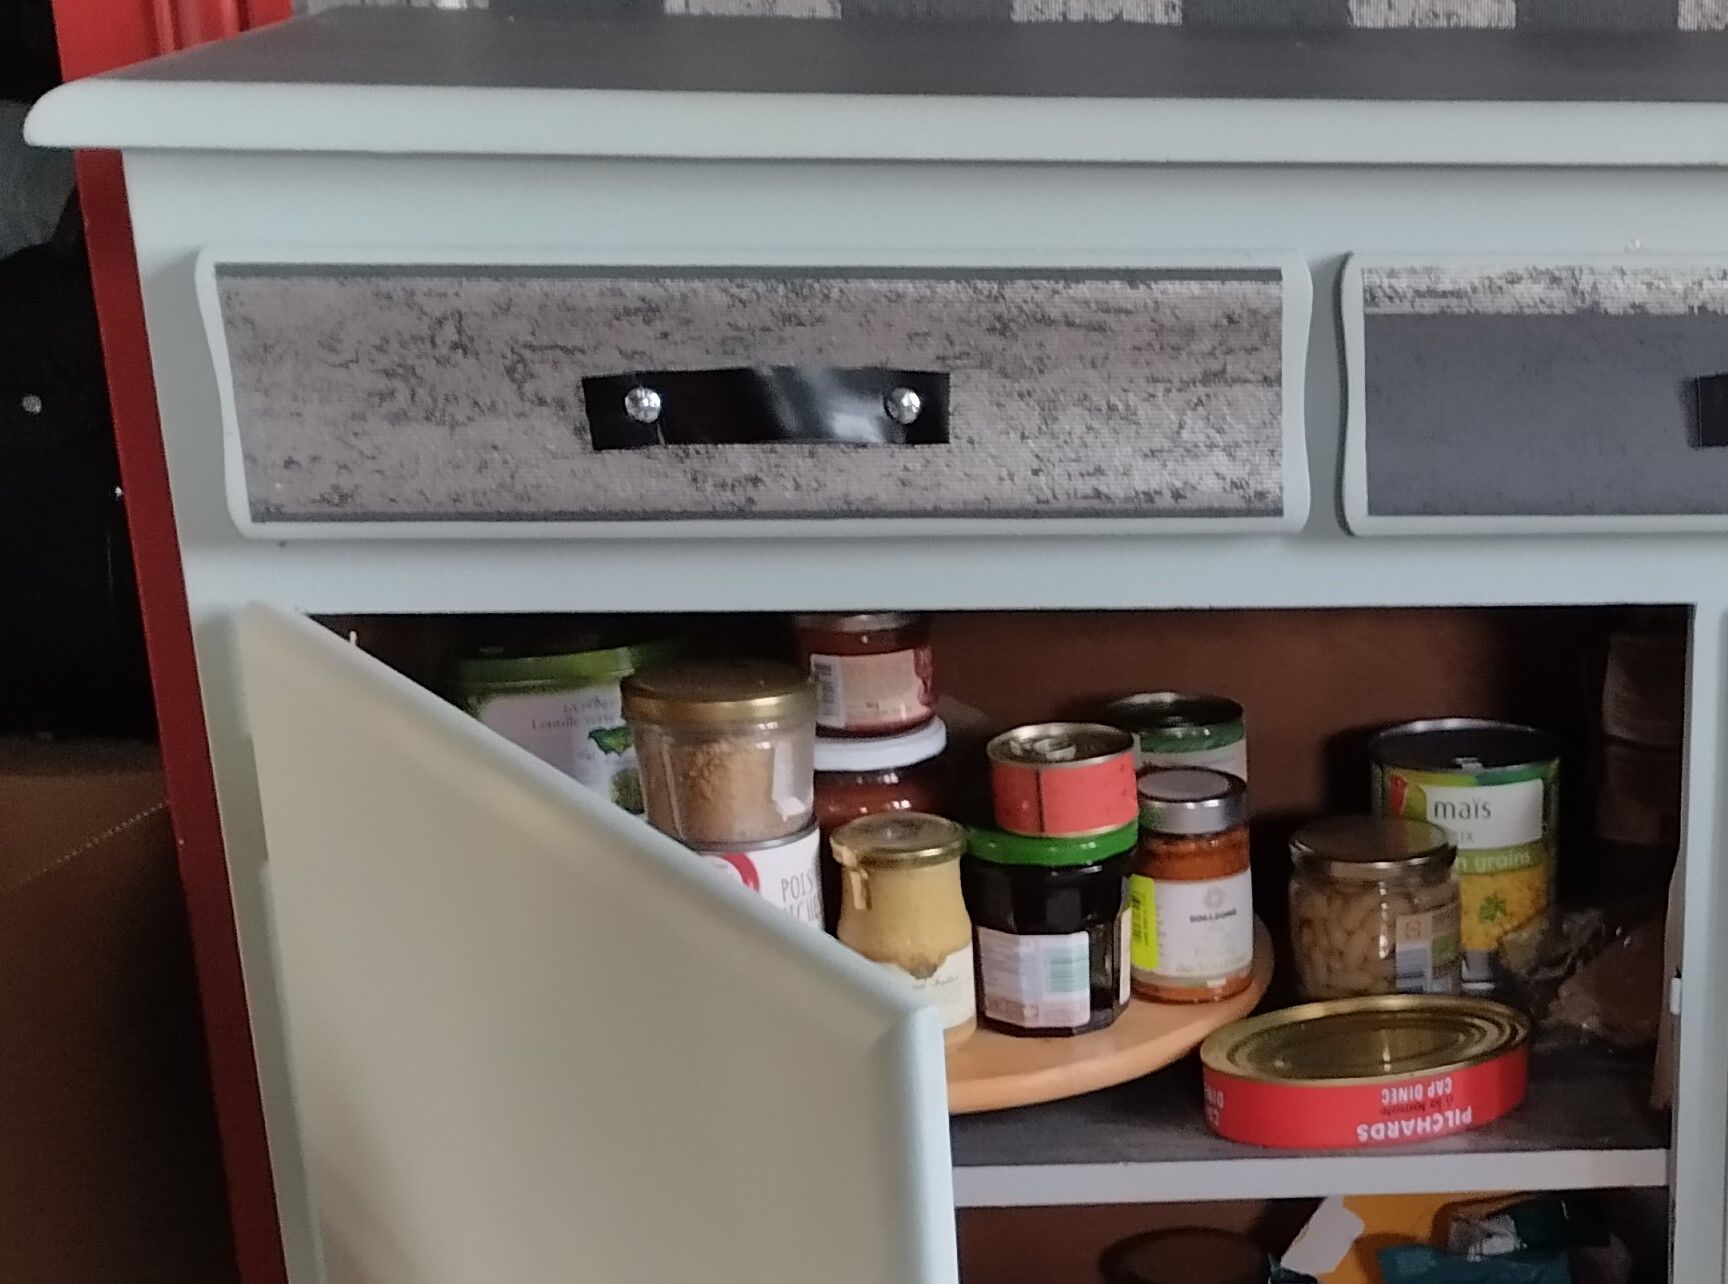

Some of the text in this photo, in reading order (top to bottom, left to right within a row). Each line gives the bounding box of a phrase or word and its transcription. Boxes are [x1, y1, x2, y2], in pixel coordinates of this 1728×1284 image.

[1434, 797, 1492, 820] maïs
[1426, 1075, 1453, 1099] CAP
[1356, 1105, 1473, 1143] PILCHARDS
